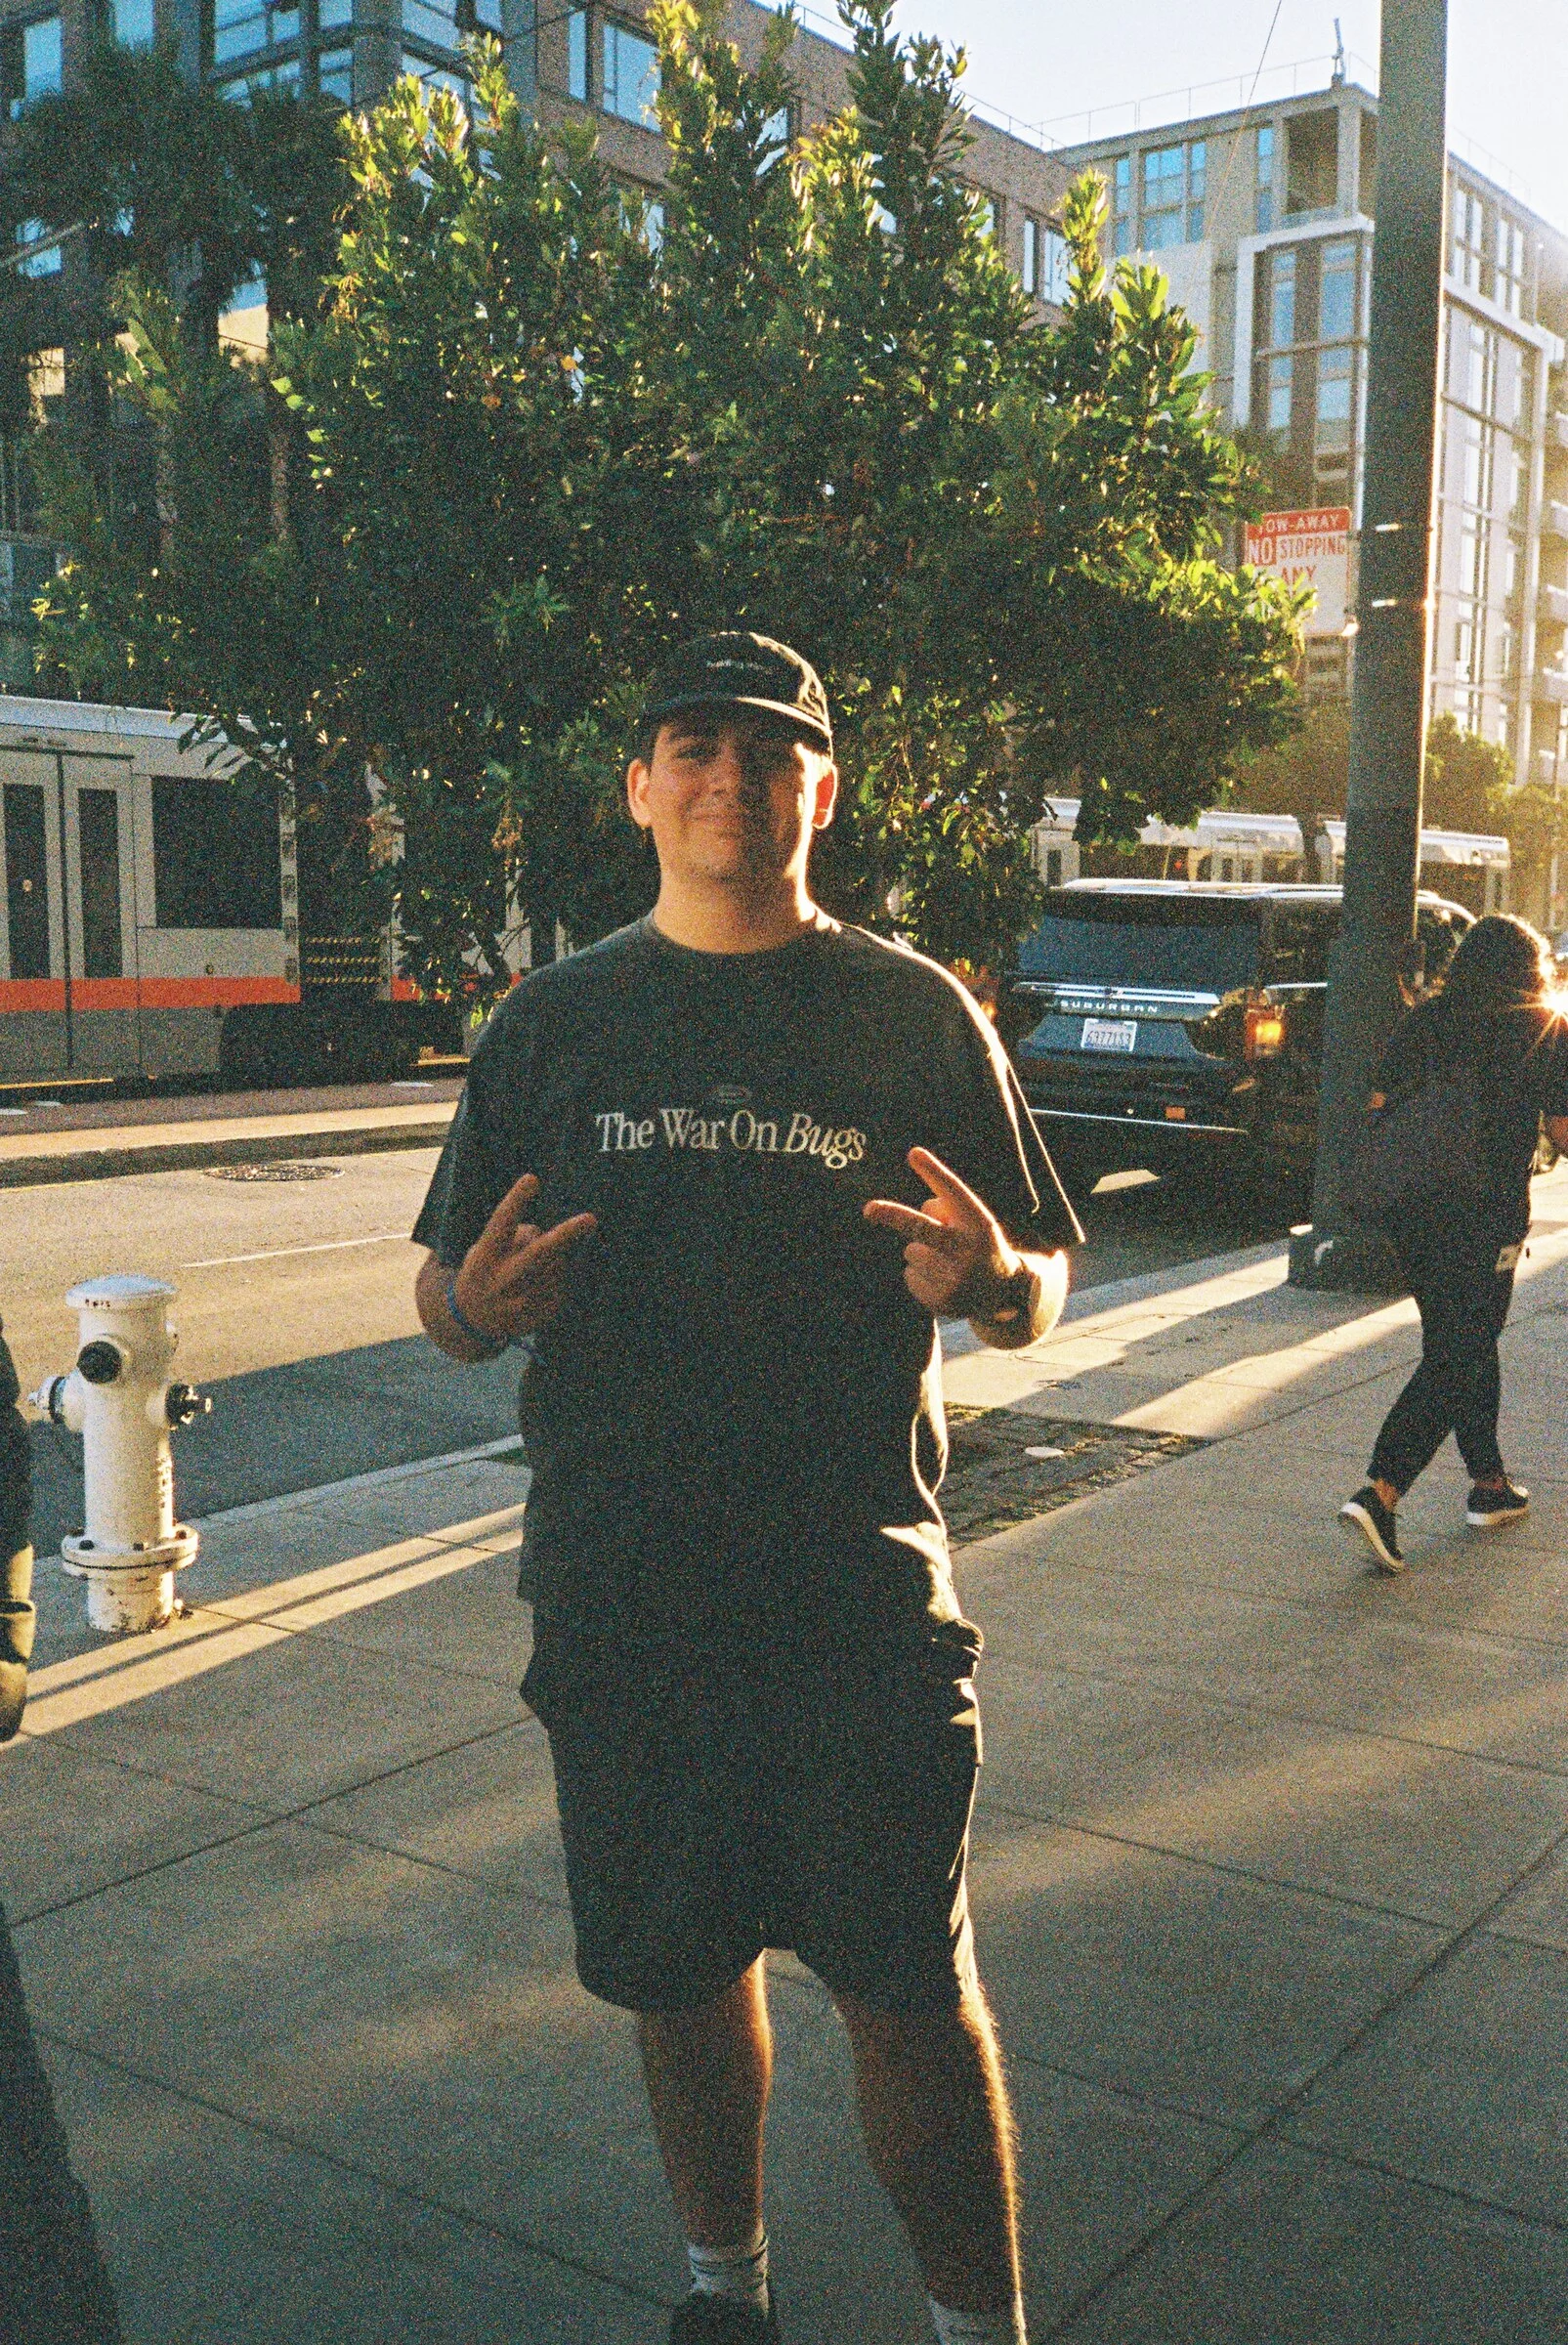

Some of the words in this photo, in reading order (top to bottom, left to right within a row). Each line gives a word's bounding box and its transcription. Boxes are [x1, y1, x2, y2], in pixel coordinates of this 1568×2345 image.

[1250, 536, 1273, 565] NO
[1279, 534, 1345, 560] STOPPING
[1060, 1000, 1158, 1013] SUBURBAN
[595, 1111, 655, 1153] The
[658, 1107, 726, 1150] War
[731, 1109, 779, 1153] On
[783, 1112, 868, 1170] Bugs
